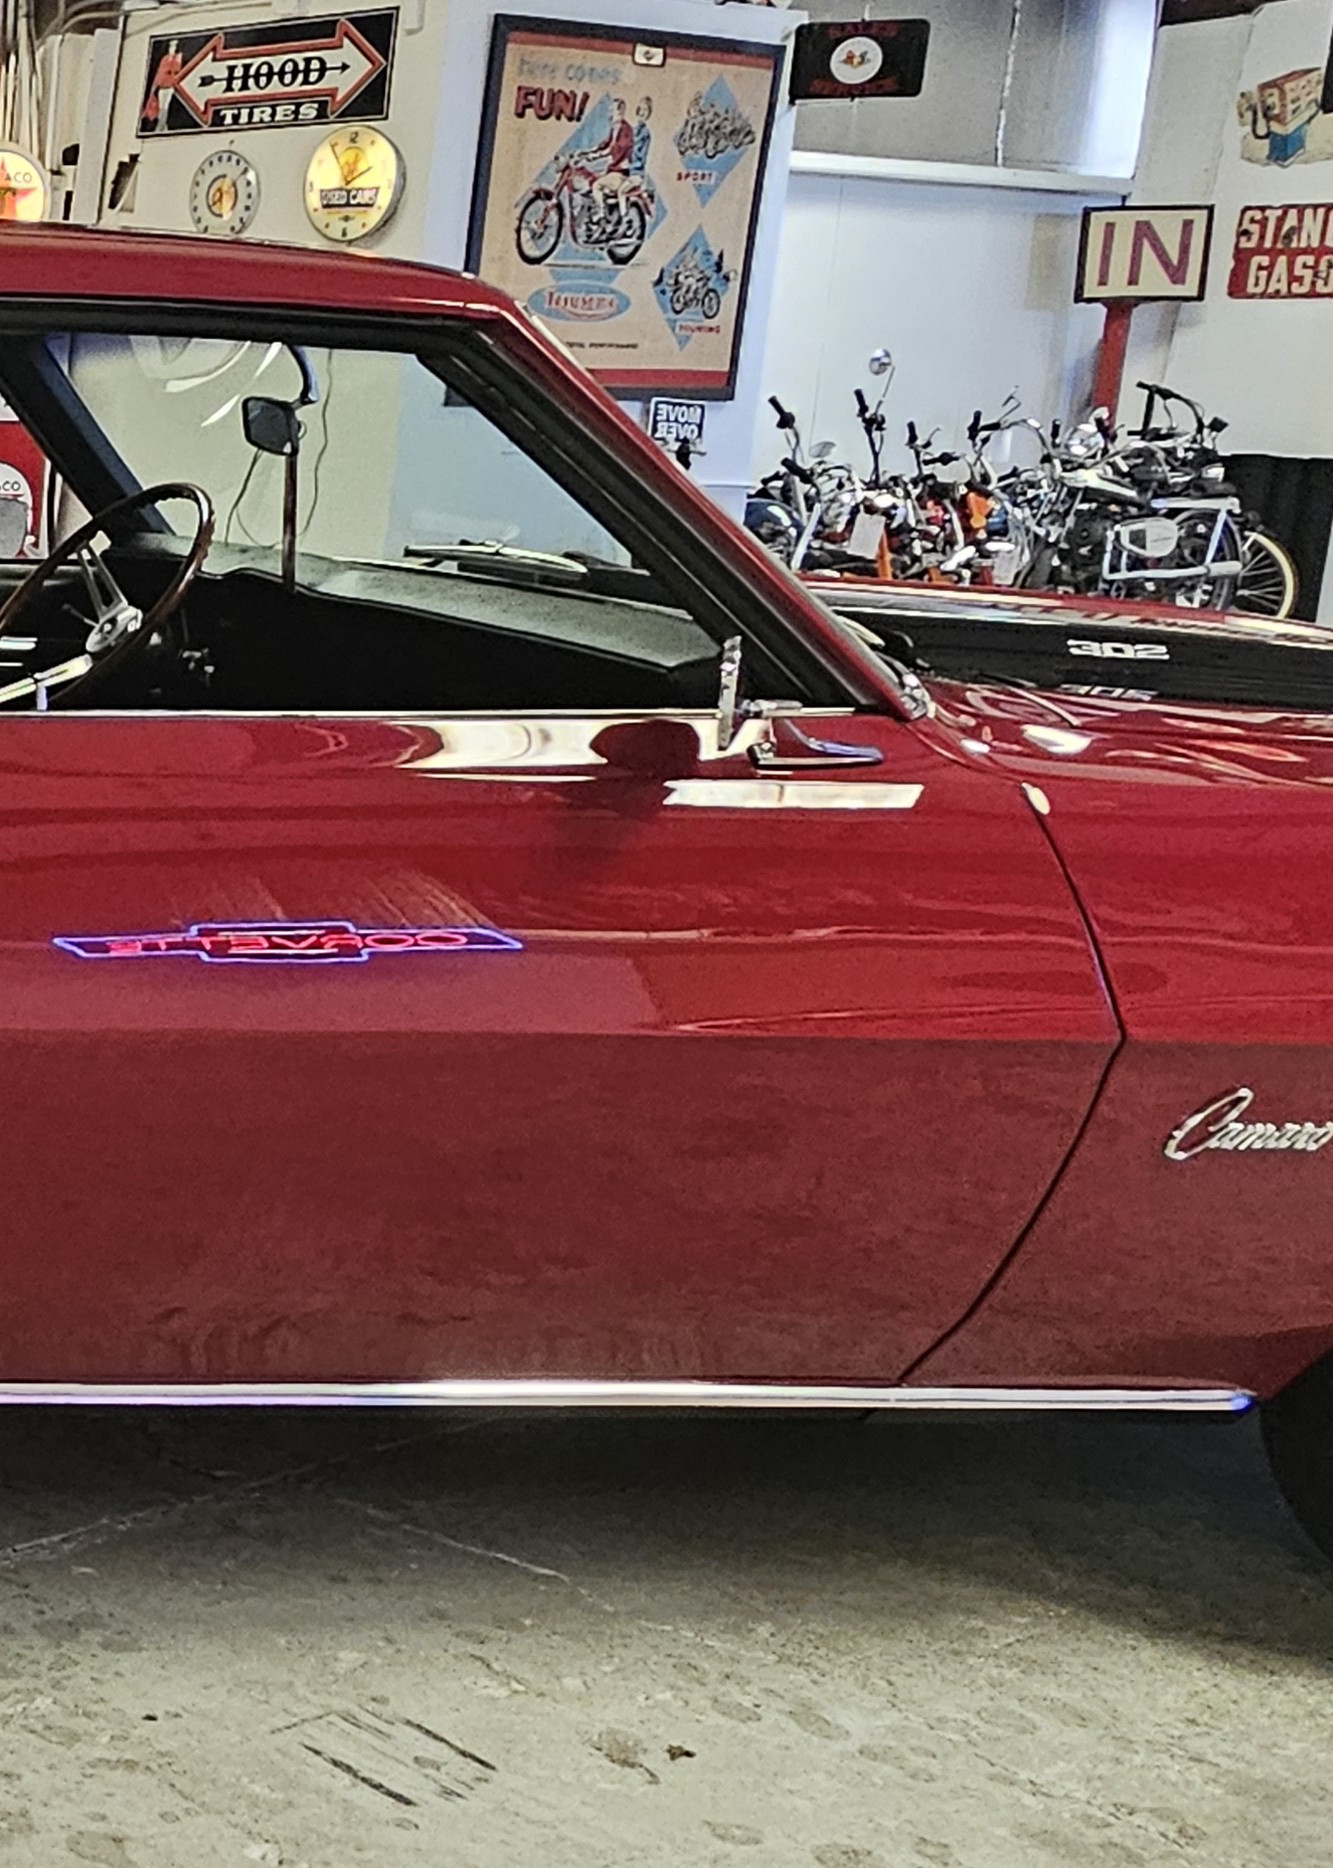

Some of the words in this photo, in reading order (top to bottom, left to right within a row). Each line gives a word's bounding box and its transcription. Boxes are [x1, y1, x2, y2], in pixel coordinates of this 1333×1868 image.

[222, 56, 329, 94] HOOD
[219, 103, 319, 126] TIRES
[514, 84, 591, 123] FUN!
[1238, 207, 1333, 249] STAN
[1096, 218, 1195, 288] IN
[1066, 639, 1170, 660] 302
[1164, 1087, 1333, 1161] Camaro
